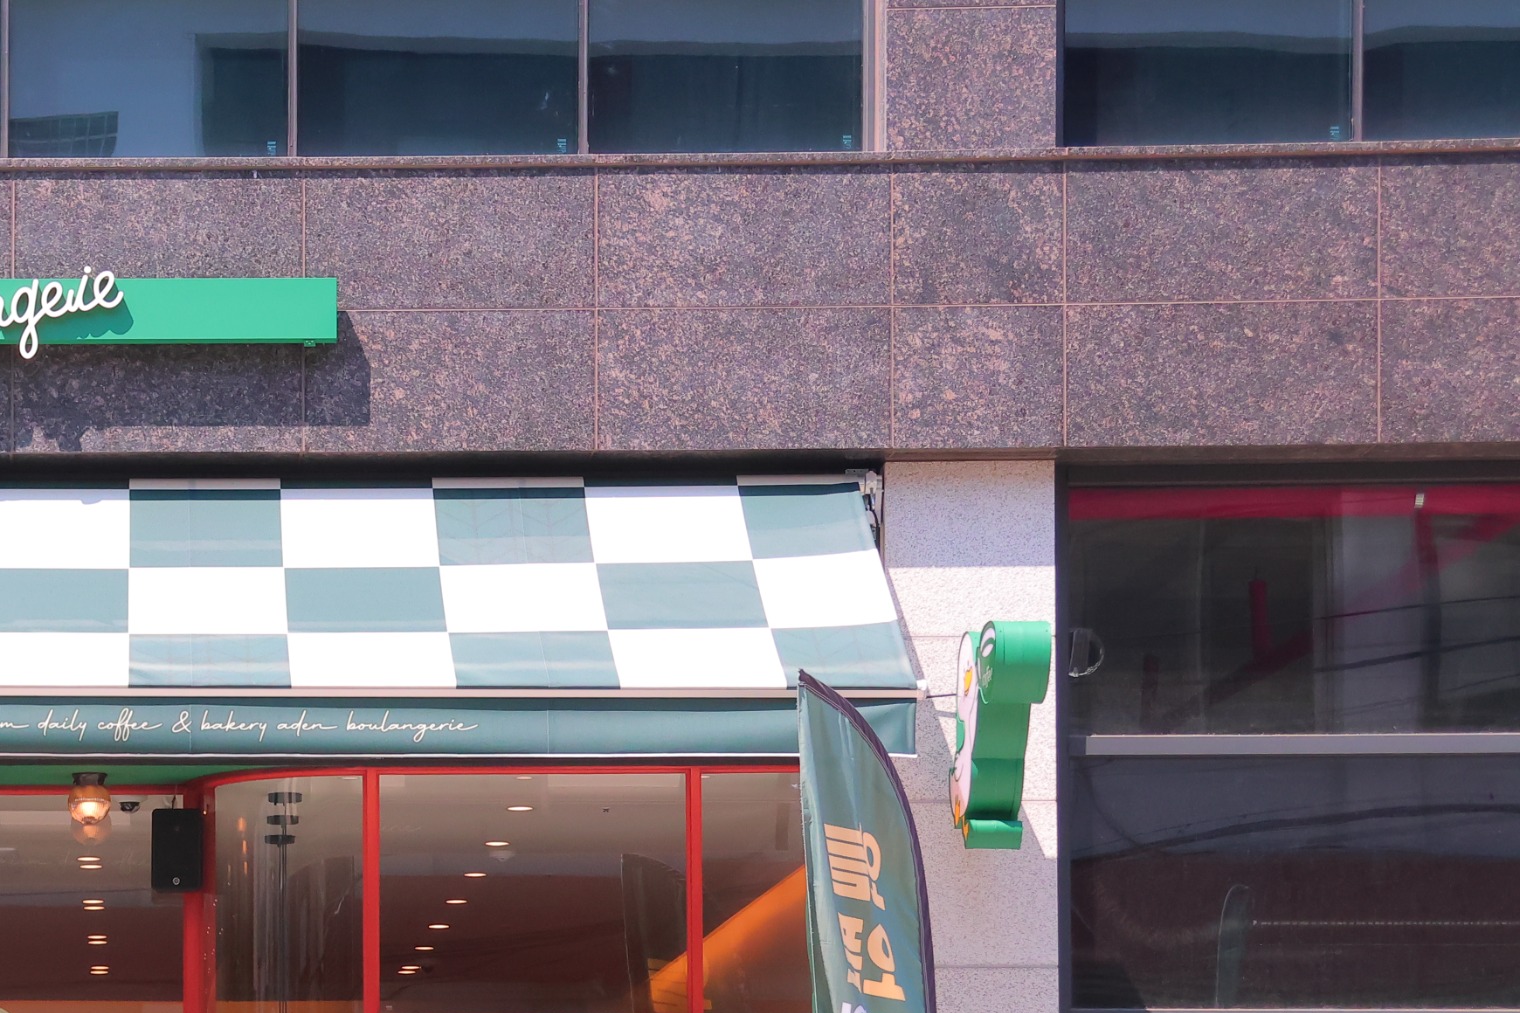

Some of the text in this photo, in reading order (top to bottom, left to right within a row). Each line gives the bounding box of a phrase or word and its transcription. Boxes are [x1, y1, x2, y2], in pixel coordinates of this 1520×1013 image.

[36, 709, 87, 740] daily
[97, 708, 162, 742] coffee
[172, 709, 191, 733] &
[200, 709, 268, 742] bakery
[277, 709, 337, 733] aden
[346, 709, 478, 742] boulangerie
